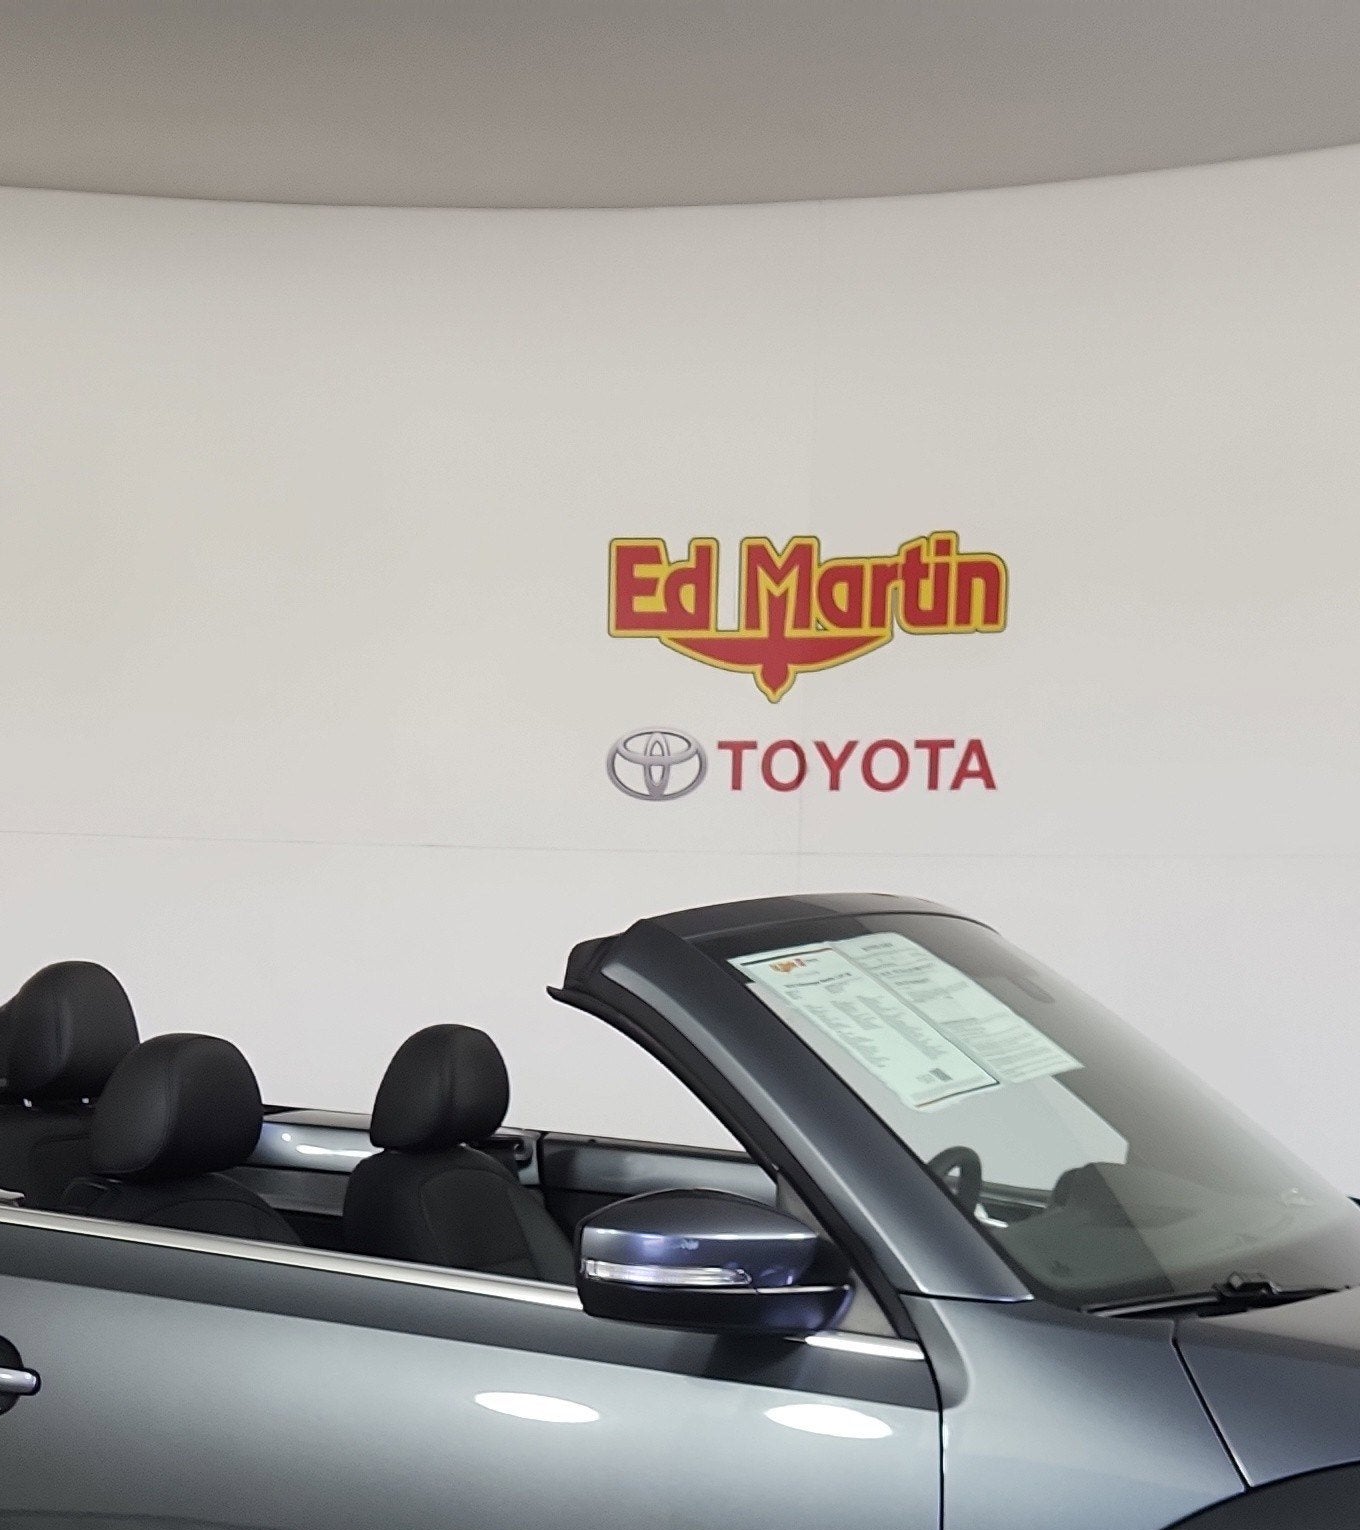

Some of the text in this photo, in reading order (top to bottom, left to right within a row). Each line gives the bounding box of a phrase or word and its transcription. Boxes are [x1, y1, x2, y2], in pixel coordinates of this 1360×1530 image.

[611, 535, 1004, 634] Ed Martin
[717, 738, 997, 792] TOYOTA
